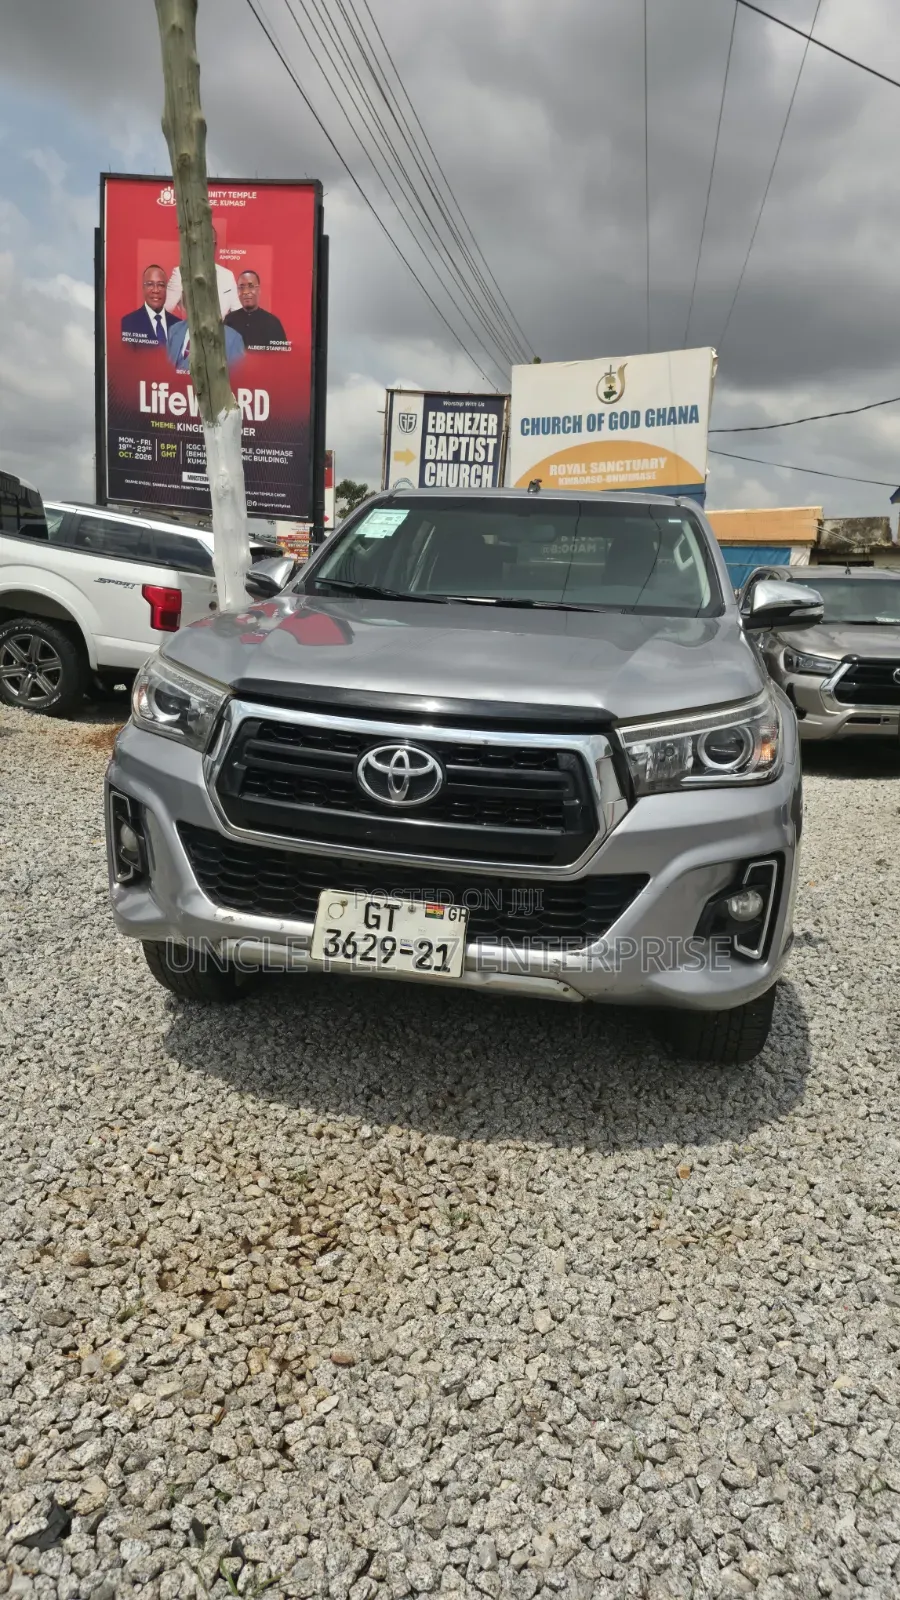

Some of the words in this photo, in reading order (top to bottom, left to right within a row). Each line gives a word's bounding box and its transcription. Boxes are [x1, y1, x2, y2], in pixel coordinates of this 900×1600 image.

[208, 190, 227, 198] INITY
[227, 191, 257, 199] TEMPLE
[140, 380, 270, 421] LifeWRD
[151, 420, 176, 430] THEME:
[176, 422, 205, 433] KINGD
[427, 411, 498, 436] EBENEZER
[520, 414, 583, 437] CHURCH
[586, 412, 605, 433] OF
[608, 410, 641, 431] GOD
[645, 404, 700, 428] GHANA
[118, 436, 135, 444] MON.
[424, 434, 498, 463] BAPTIST
[161, 450, 177, 458] GMT
[186, 450, 207, 458] (BEHIN
[187, 457, 207, 465] KUMA
[255, 448, 294, 457] OHWIMASE
[424, 461, 494, 488] CHURCH
[549, 463, 588, 477] ROYAL
[590, 457, 668, 474] SANCTUARY
[364, 902, 402, 932] GT
[448, 908, 469, 923] GH
[322, 928, 451, 972] 3629-21
